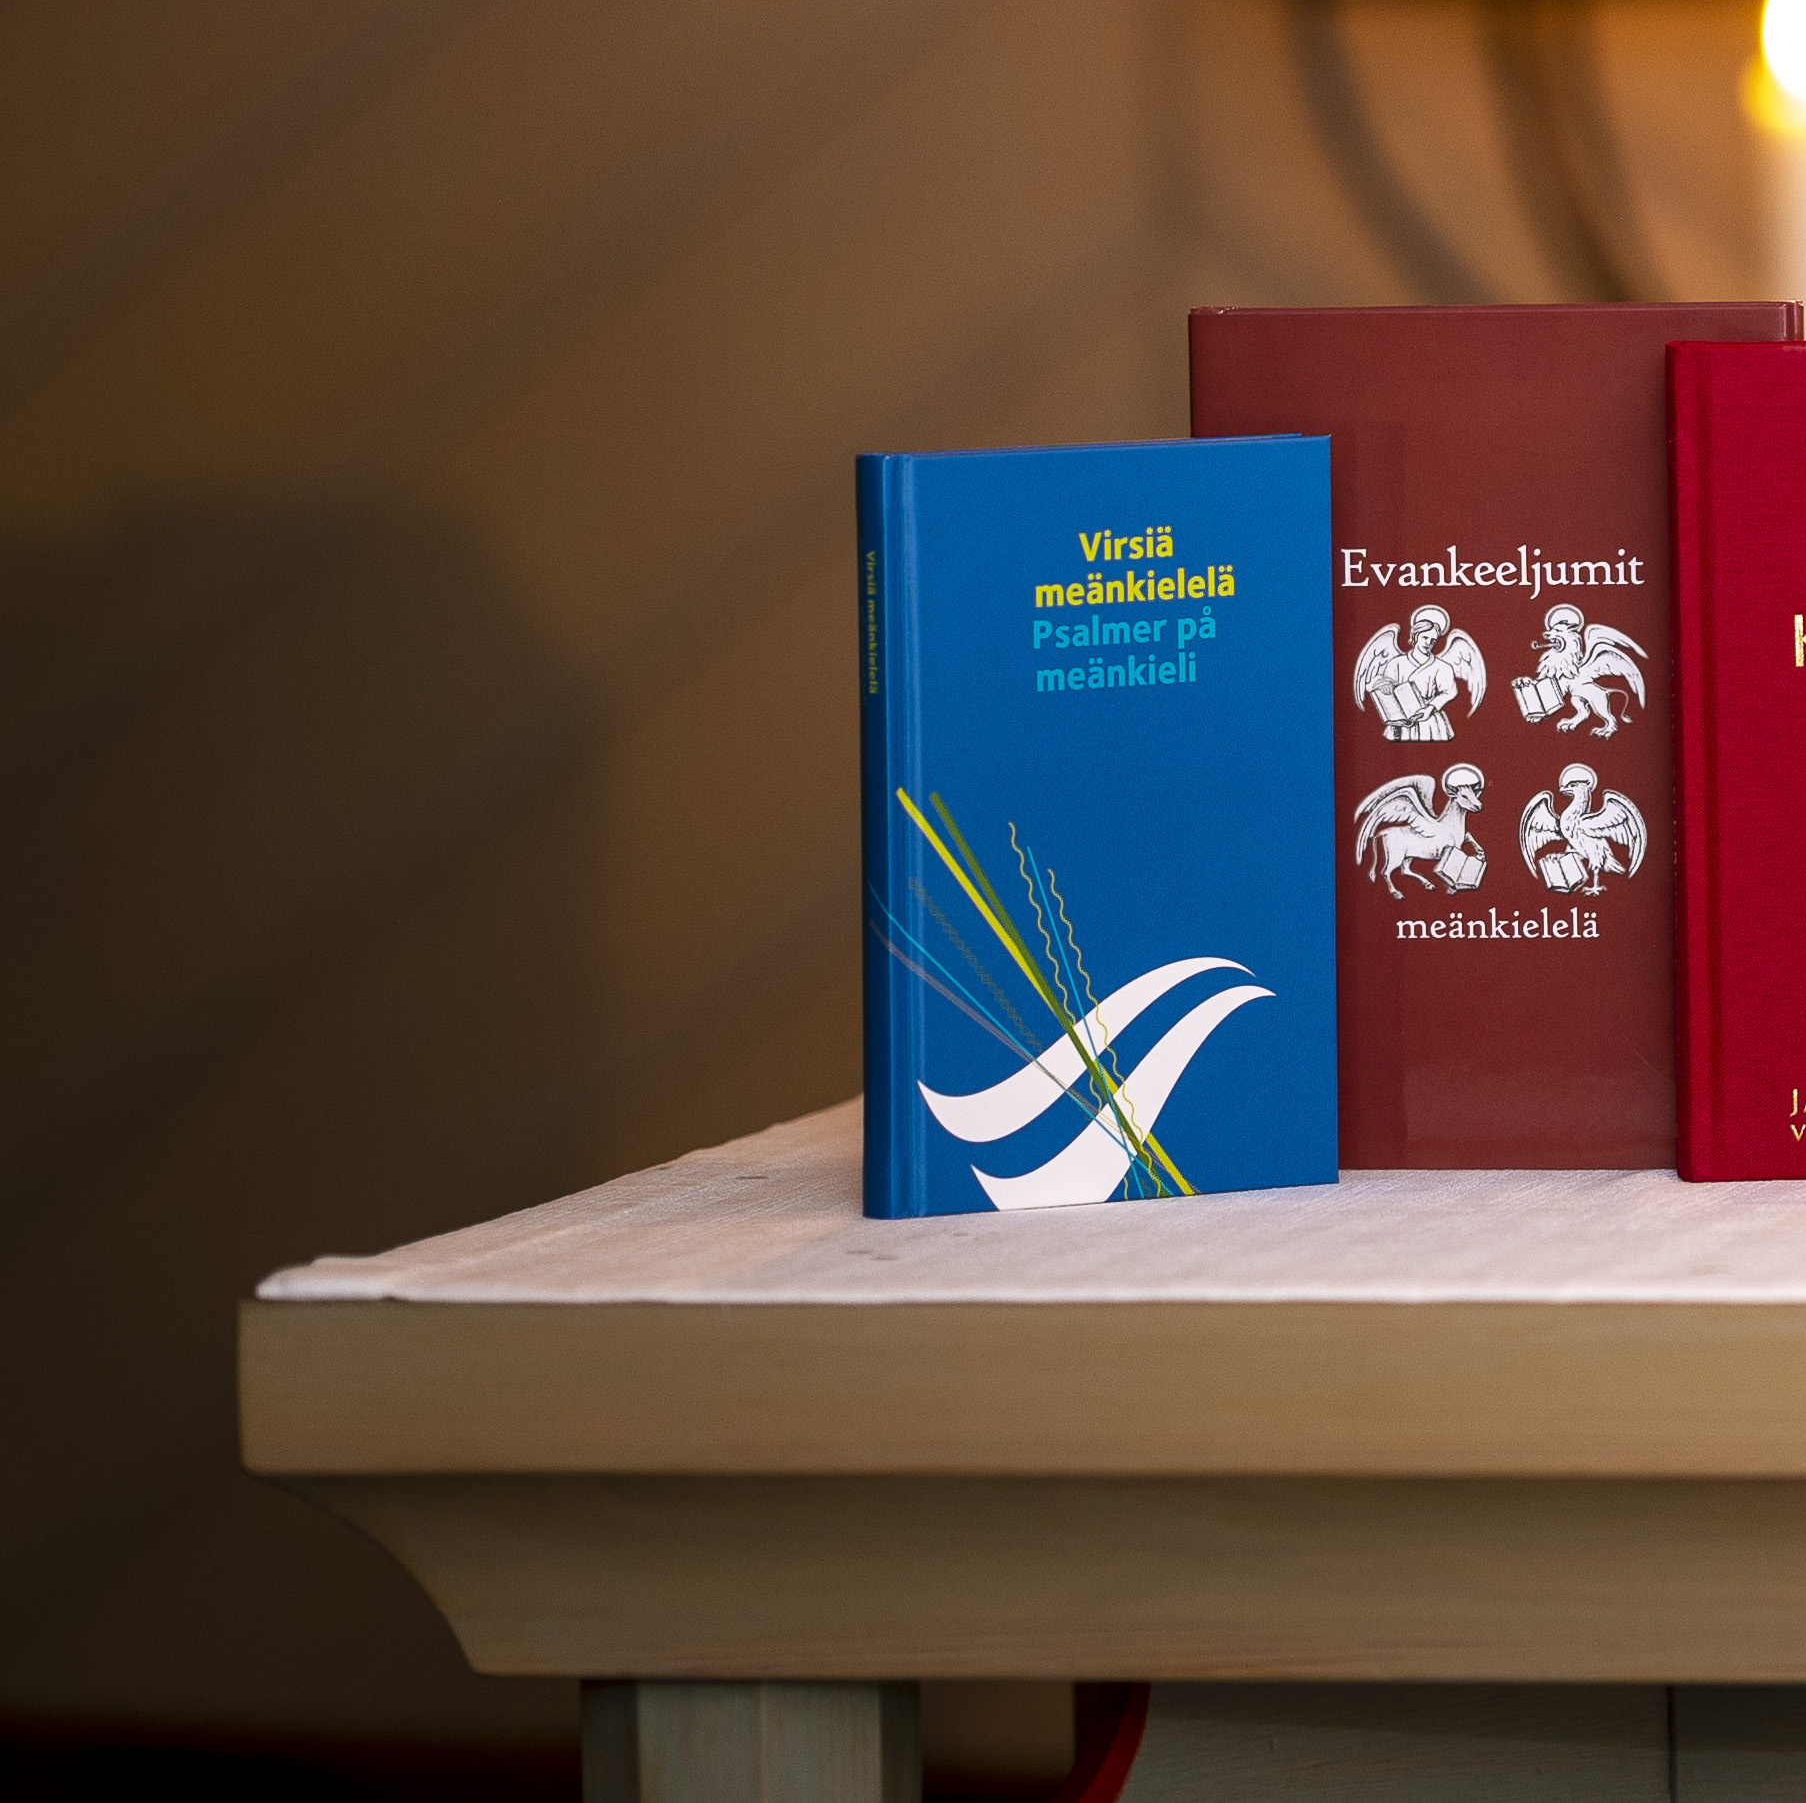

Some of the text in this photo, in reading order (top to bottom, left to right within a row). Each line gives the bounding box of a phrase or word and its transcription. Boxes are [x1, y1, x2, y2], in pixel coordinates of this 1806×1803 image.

[1078, 525, 1173, 562] Virsiä
[866, 551, 876, 595] Virsiä
[1035, 565, 1235, 609] meänkielelä
[1340, 544, 1645, 600] Evankeeljumit
[1033, 604, 1216, 651] Psalmer på
[1036, 651, 1196, 692] meänkieli
[1396, 906, 1600, 939] meänkielelä
